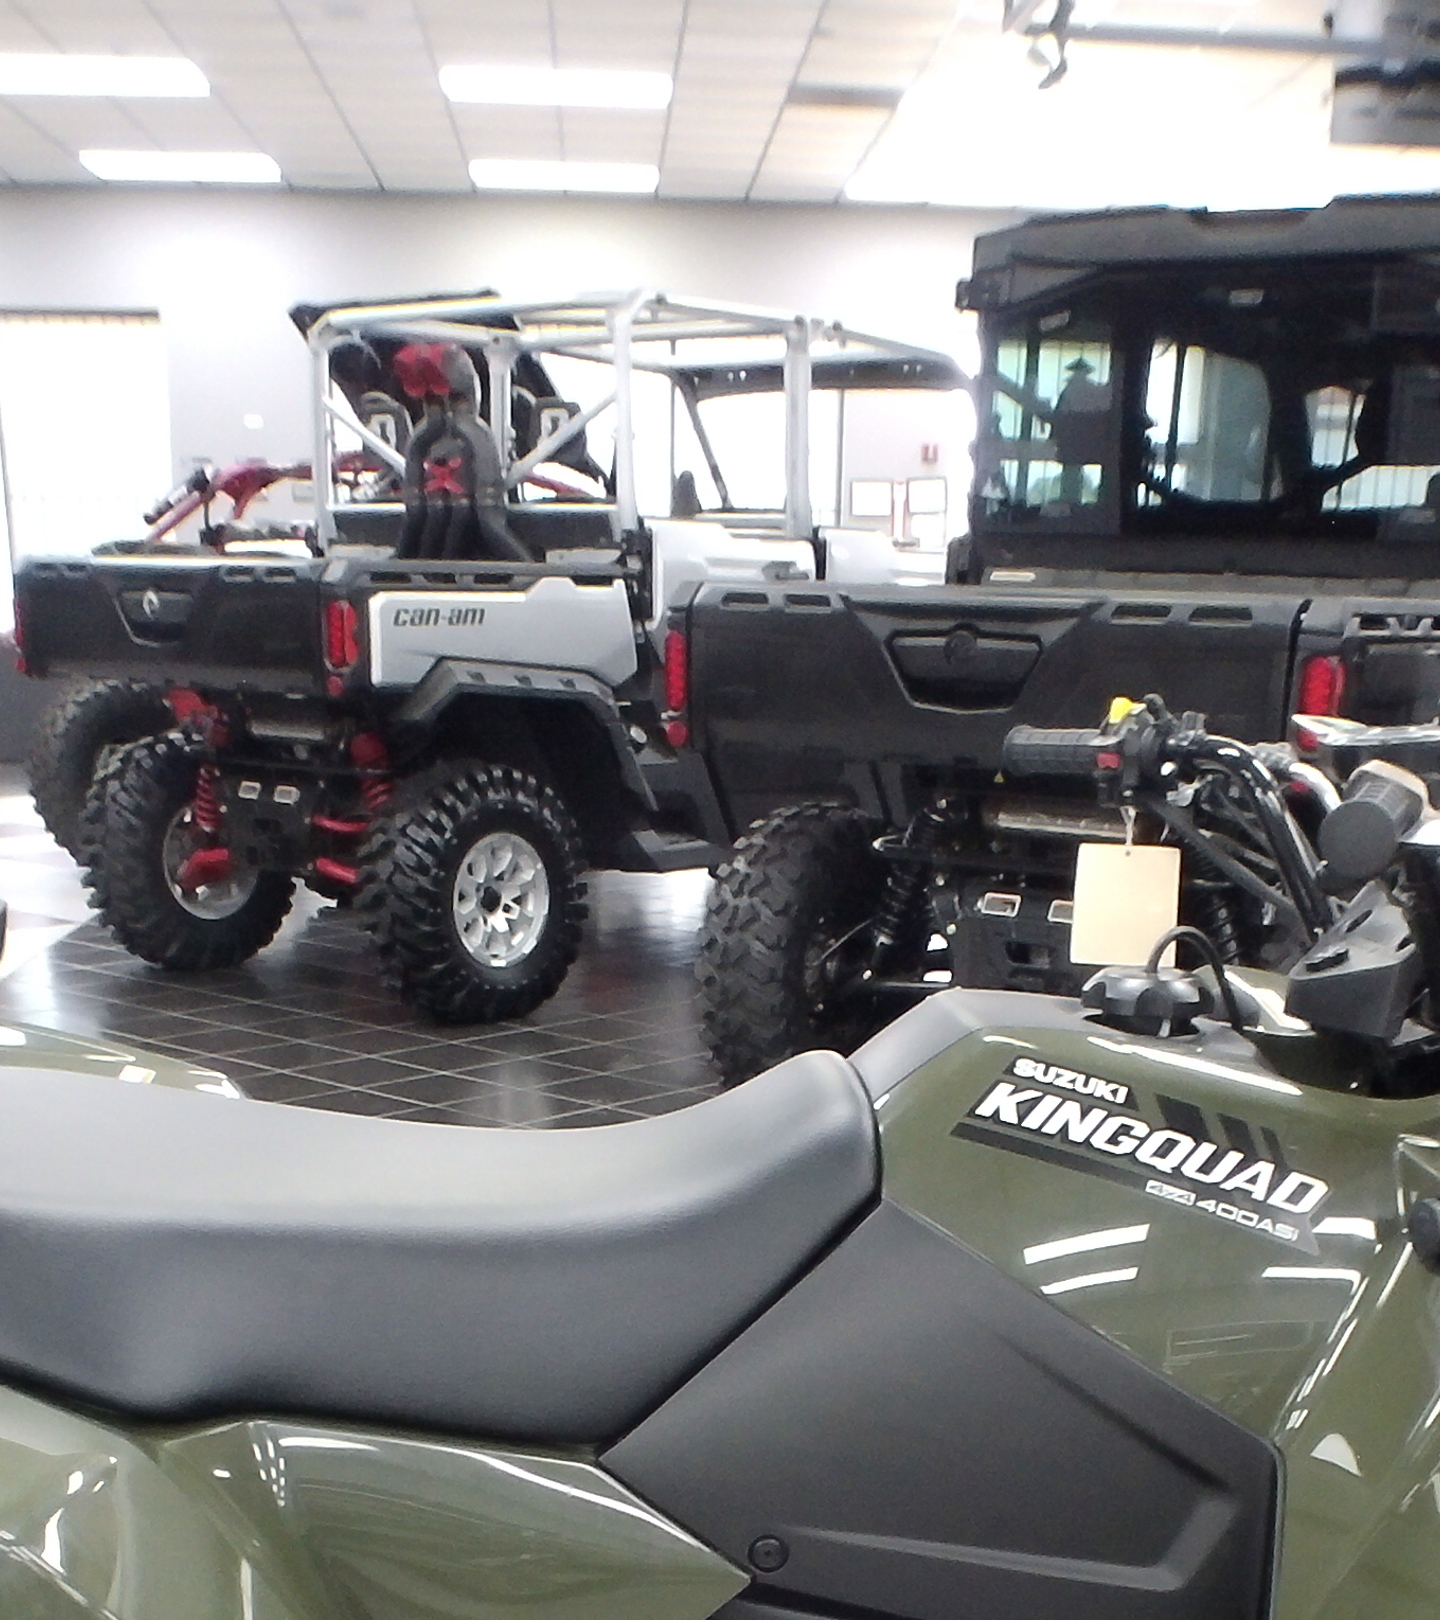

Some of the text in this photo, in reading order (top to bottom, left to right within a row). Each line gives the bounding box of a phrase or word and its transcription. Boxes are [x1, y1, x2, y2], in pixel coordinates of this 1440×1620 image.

[393, 607, 485, 627] can-am
[1012, 1057, 1130, 1105] SUZUKI
[974, 1082, 1330, 1214] KINGQUAD
